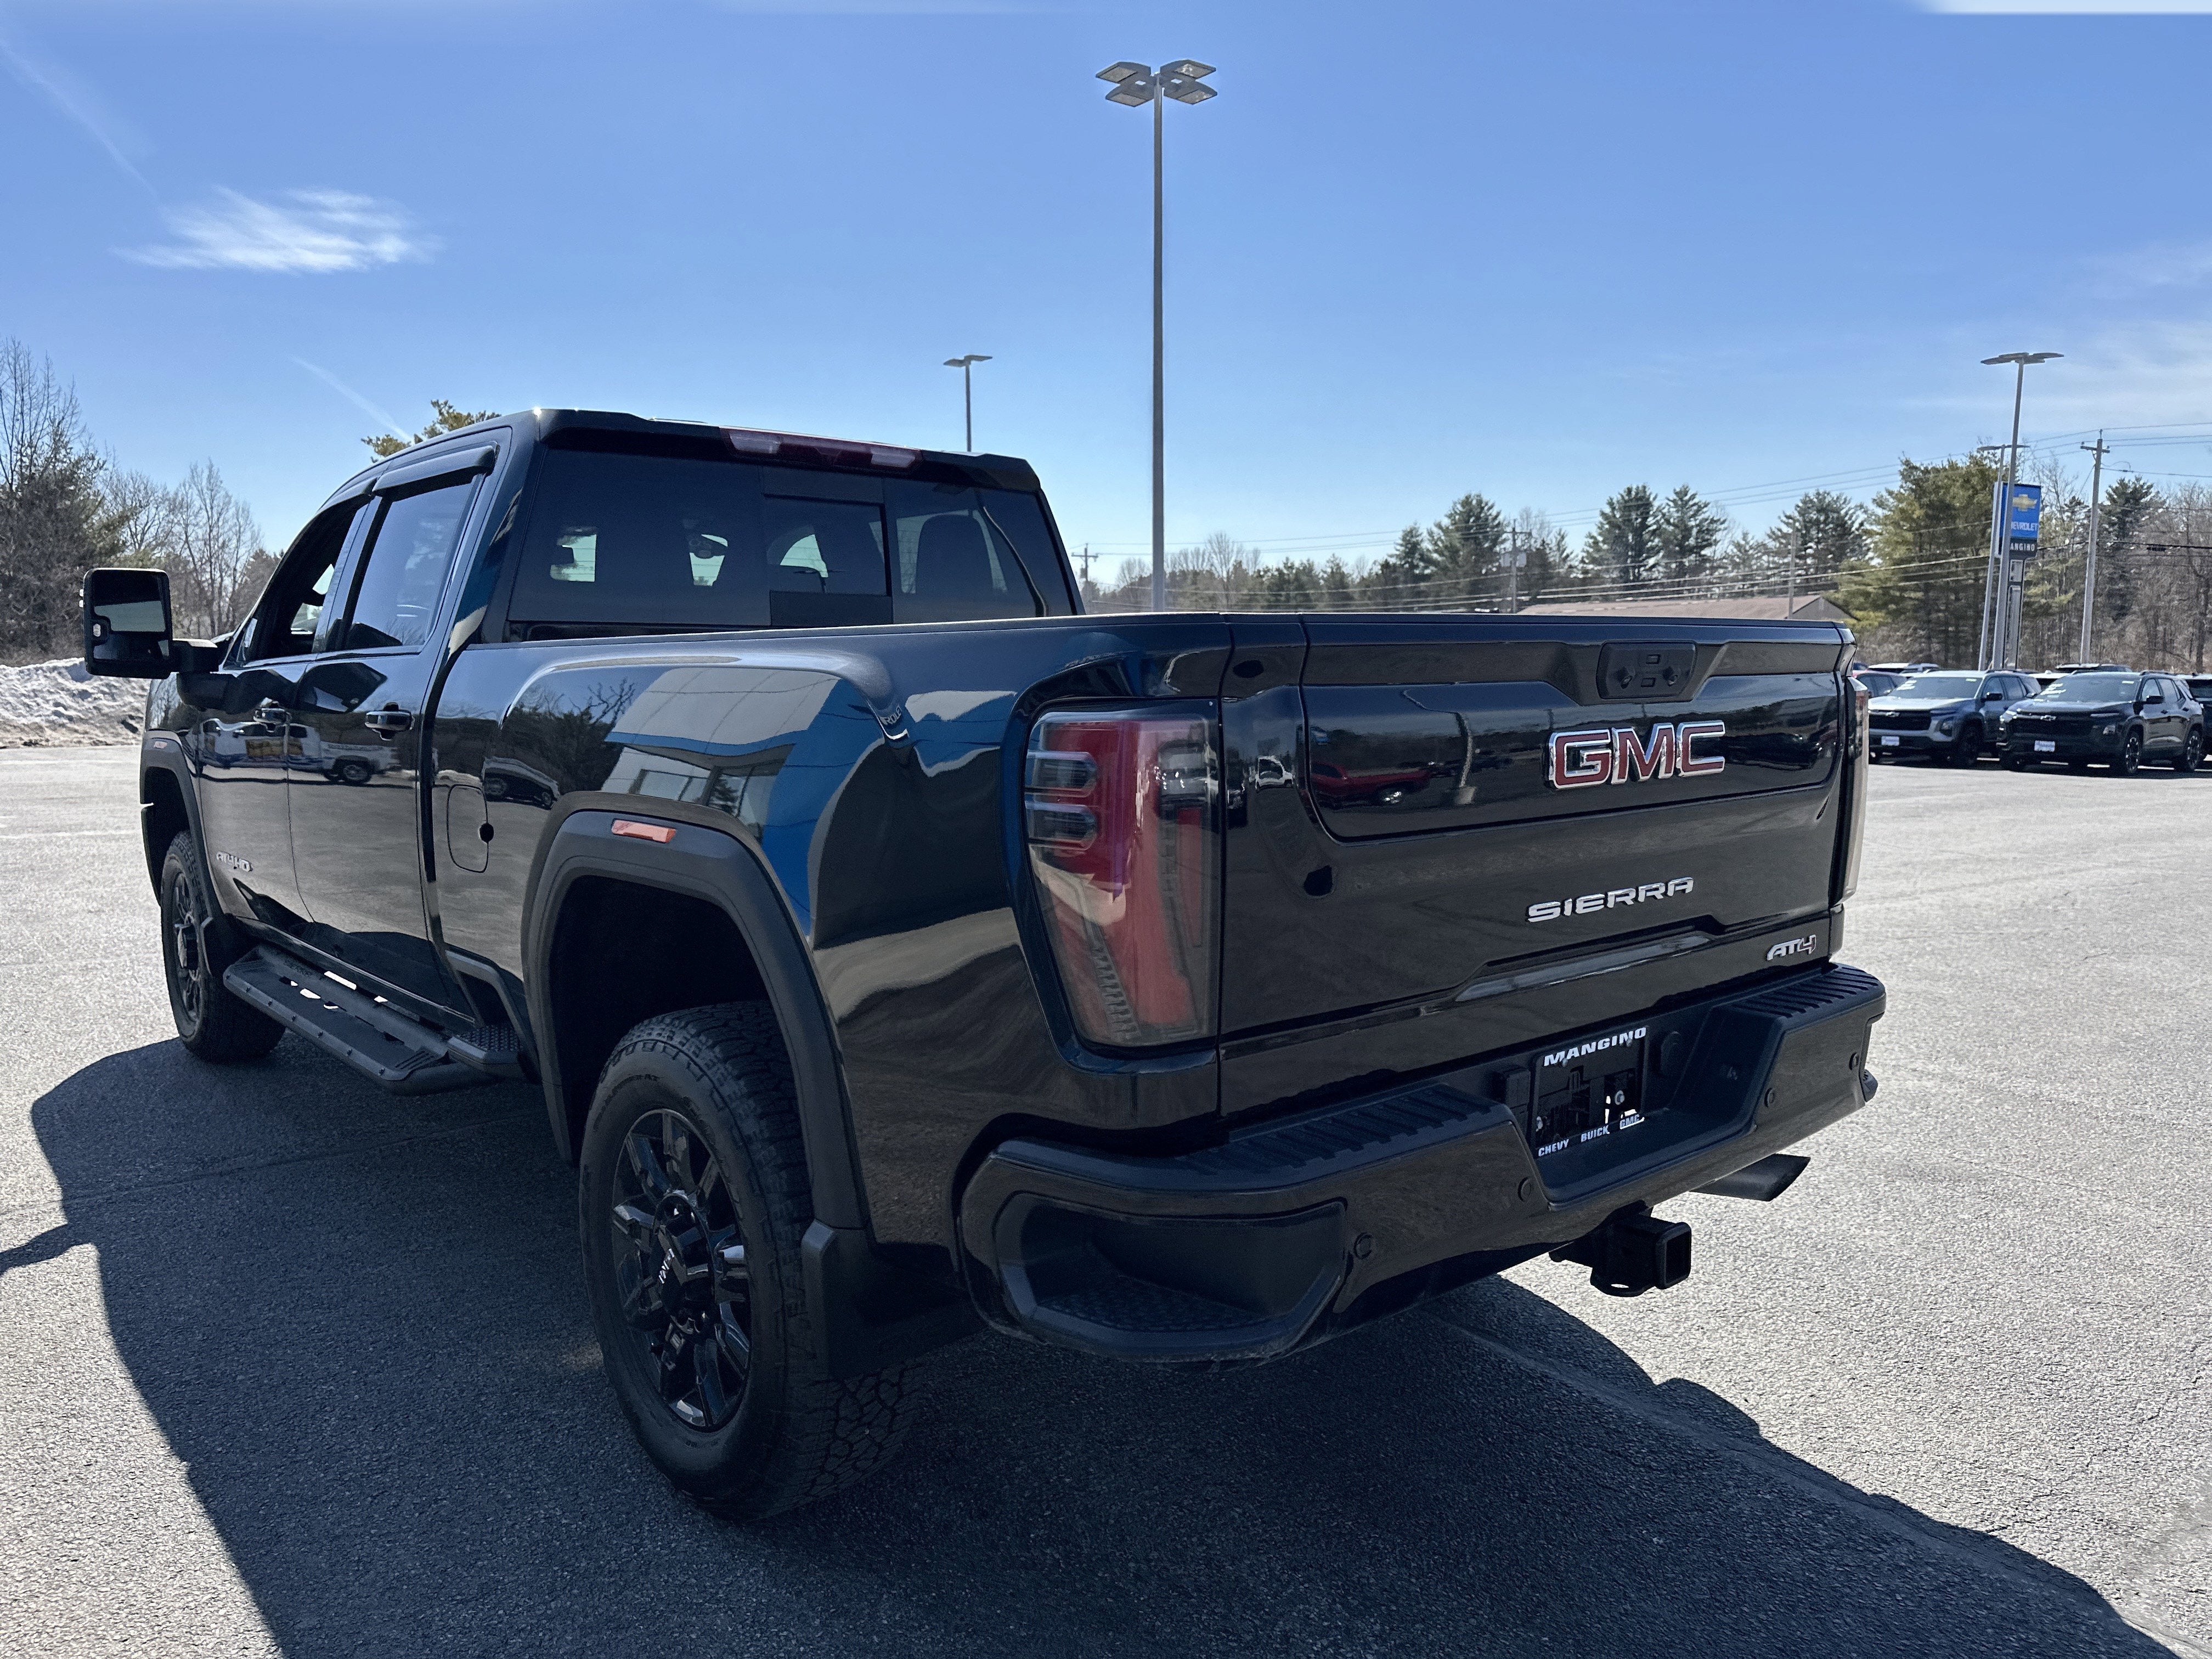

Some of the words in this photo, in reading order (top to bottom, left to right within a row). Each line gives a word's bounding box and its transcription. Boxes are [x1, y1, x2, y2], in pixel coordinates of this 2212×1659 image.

[2011, 521, 2038, 531] EVROLET
[2010, 542, 2035, 551] ANGINO
[1549, 720, 1725, 789] GMC
[1528, 877, 1694, 923] SIERRA
[1767, 934, 1816, 961] AT4
[1544, 1027, 1646, 1066] MANGINO
[1538, 1139, 1569, 1157] CHEVY
[1581, 1125, 1609, 1142] BUICK
[1619, 1114, 1640, 1128] GMC
